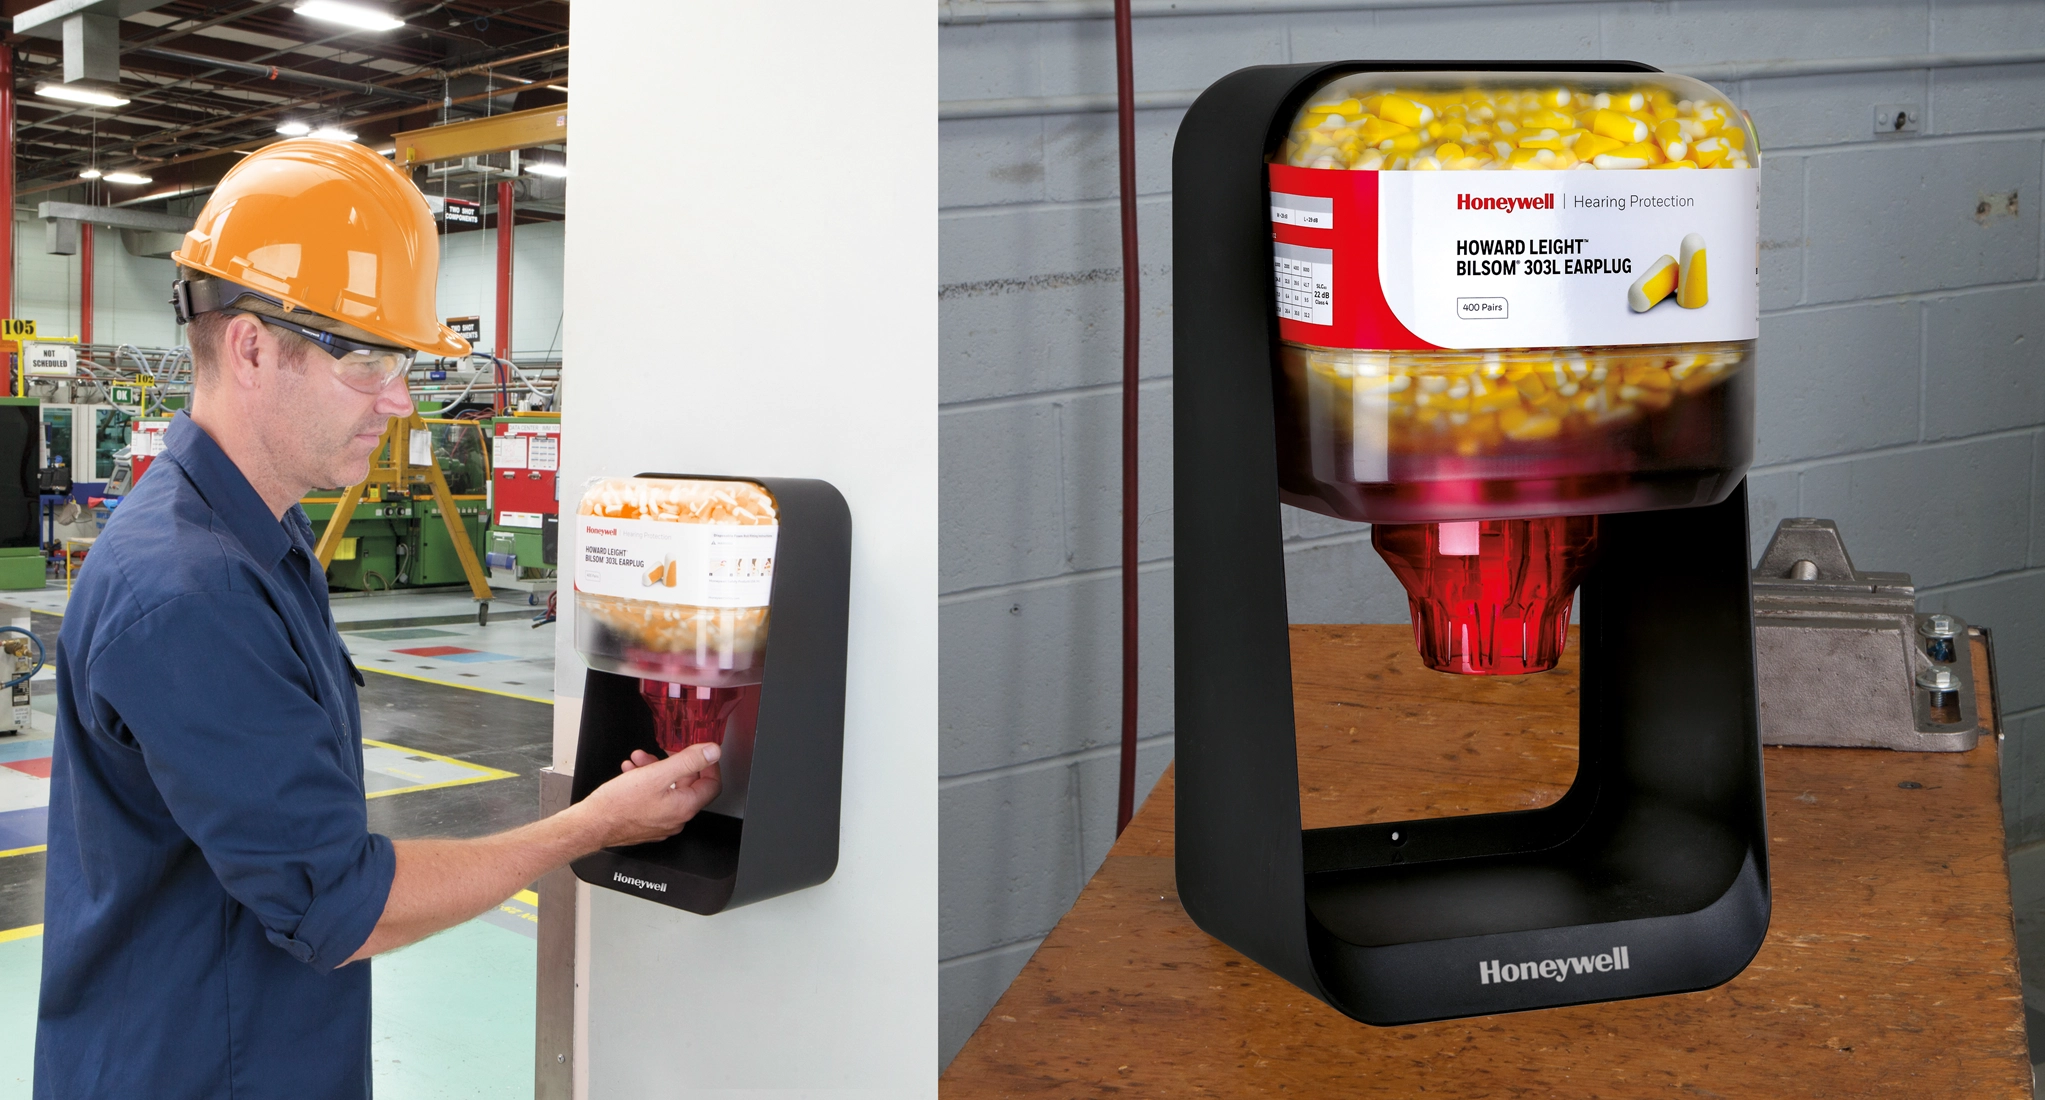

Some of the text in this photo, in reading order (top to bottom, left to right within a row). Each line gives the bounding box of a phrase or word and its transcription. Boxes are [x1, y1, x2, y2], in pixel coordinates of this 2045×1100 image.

[1457, 193, 1554, 213] Honeywell
[1574, 194, 1694, 210] Hearing Protection
[462, 207, 475, 216] SHOT
[1456, 240, 1526, 256] HOWARD
[1524, 259, 1560, 275] 303L
[1564, 258, 1632, 274] EARPLUG
[1462, 303, 1502, 312] 400 Pairs
[4, 320, 34, 335] 105
[138, 375, 154, 383] 102
[116, 390, 128, 400] OK
[586, 526, 617, 536] Honeywell
[623, 530, 672, 540] Hearing Protection
[586, 546, 606, 555] HOWARD
[606, 556, 618, 565] 303L
[619, 558, 645, 568] EARPLUG
[613, 872, 667, 892] Honeywell
[1479, 946, 1630, 985] Honeywell
